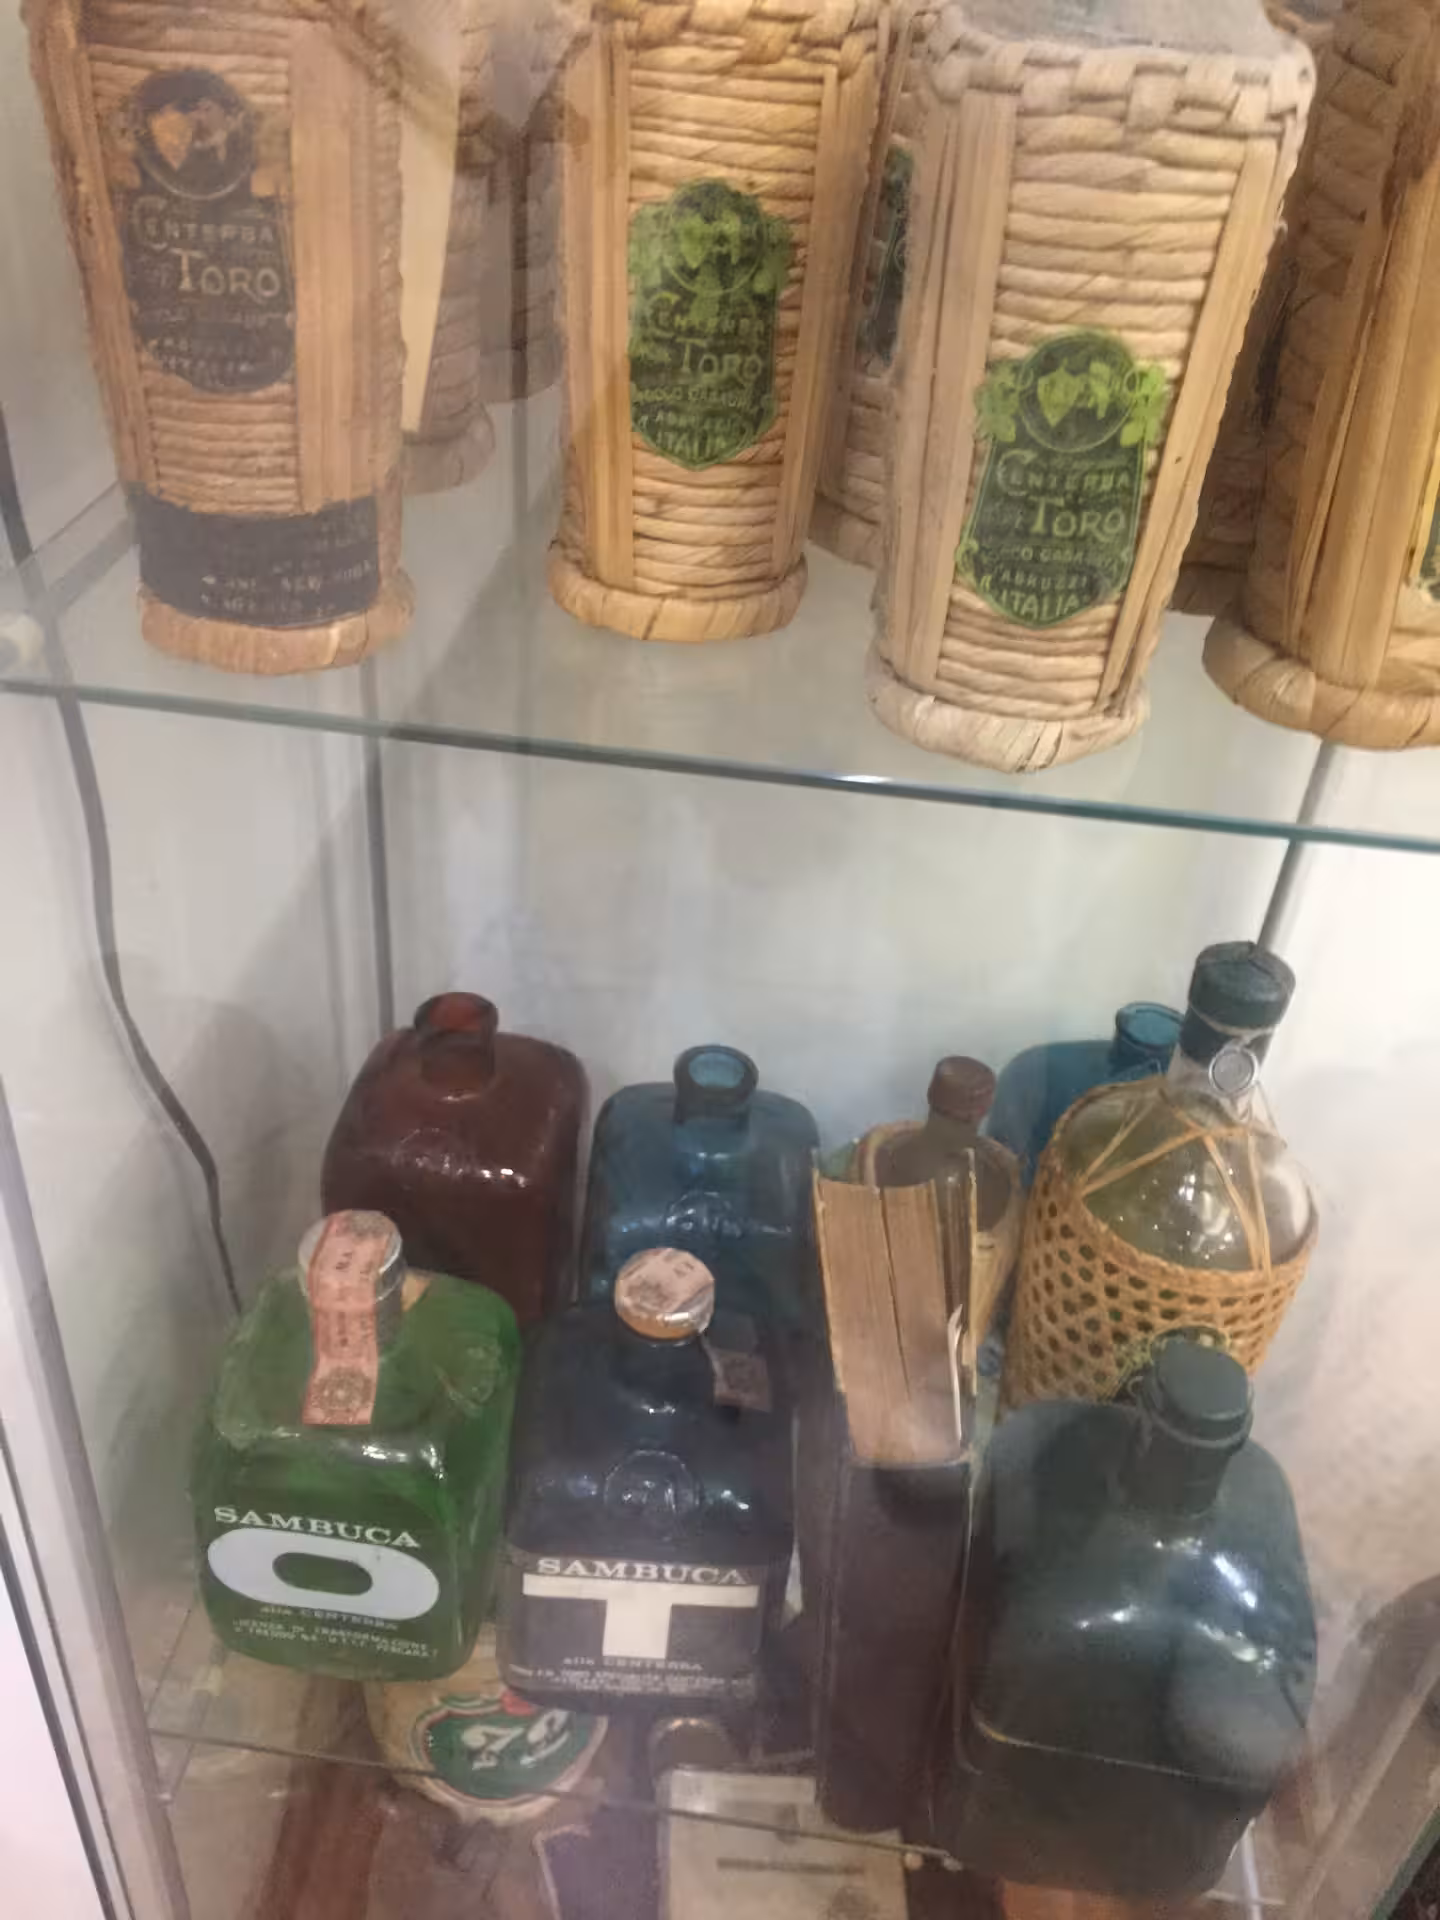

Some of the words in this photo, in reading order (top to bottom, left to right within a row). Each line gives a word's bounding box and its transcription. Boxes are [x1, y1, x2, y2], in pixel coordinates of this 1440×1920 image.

[169, 246, 281, 305] TORO
[676, 336, 763, 385] TORO
[1027, 496, 1126, 543] TORO
[1000, 590, 1081, 621] ITALIA
[214, 1505, 421, 1549] SAMBUCA
[536, 1556, 747, 1586] SAMBUCA
